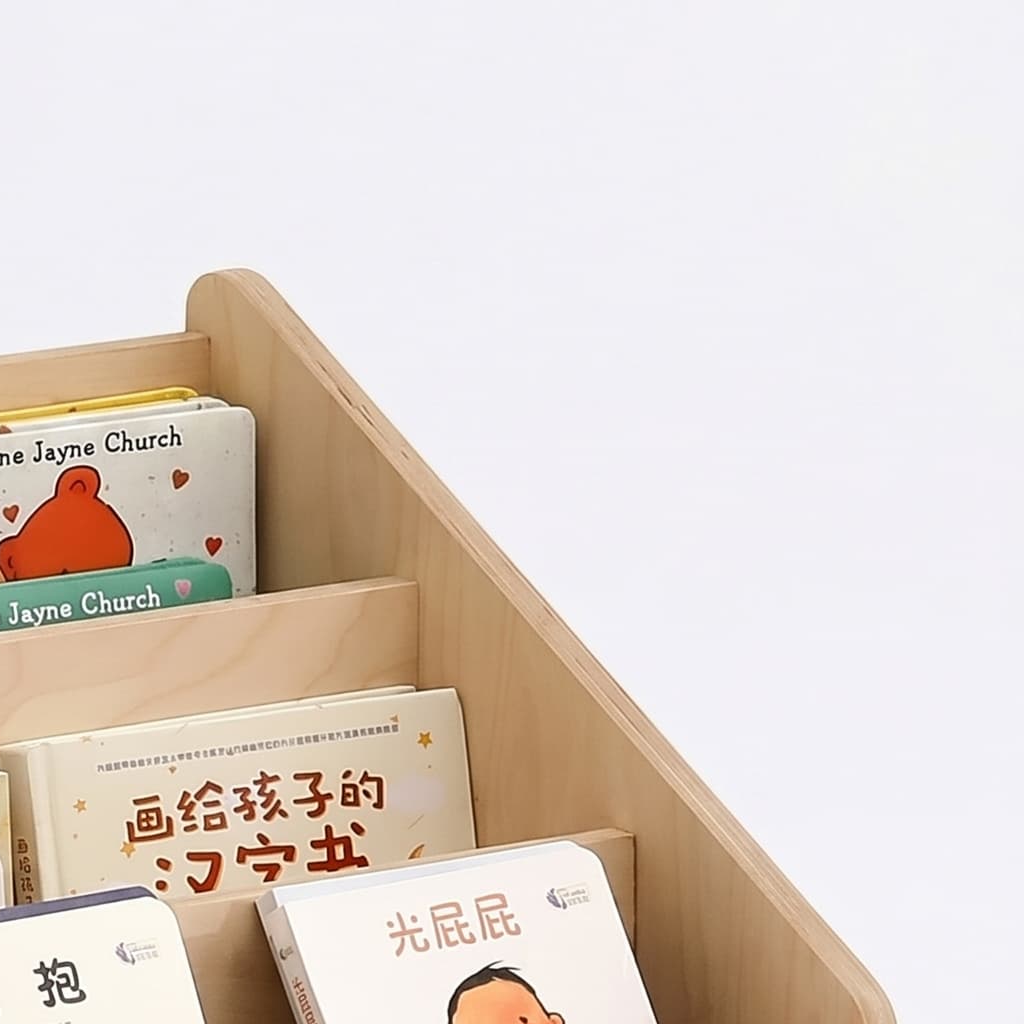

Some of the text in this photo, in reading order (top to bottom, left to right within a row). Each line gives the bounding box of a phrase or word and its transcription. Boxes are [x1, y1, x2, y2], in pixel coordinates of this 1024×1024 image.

[33, 440, 95, 466] Jayne
[105, 425, 182, 453] Church
[8, 602, 73, 627] Jayne
[81, 585, 161, 615] Church
[126, 769, 385, 844] 画给孩子的
[386, 892, 522, 957] 光屁屁
